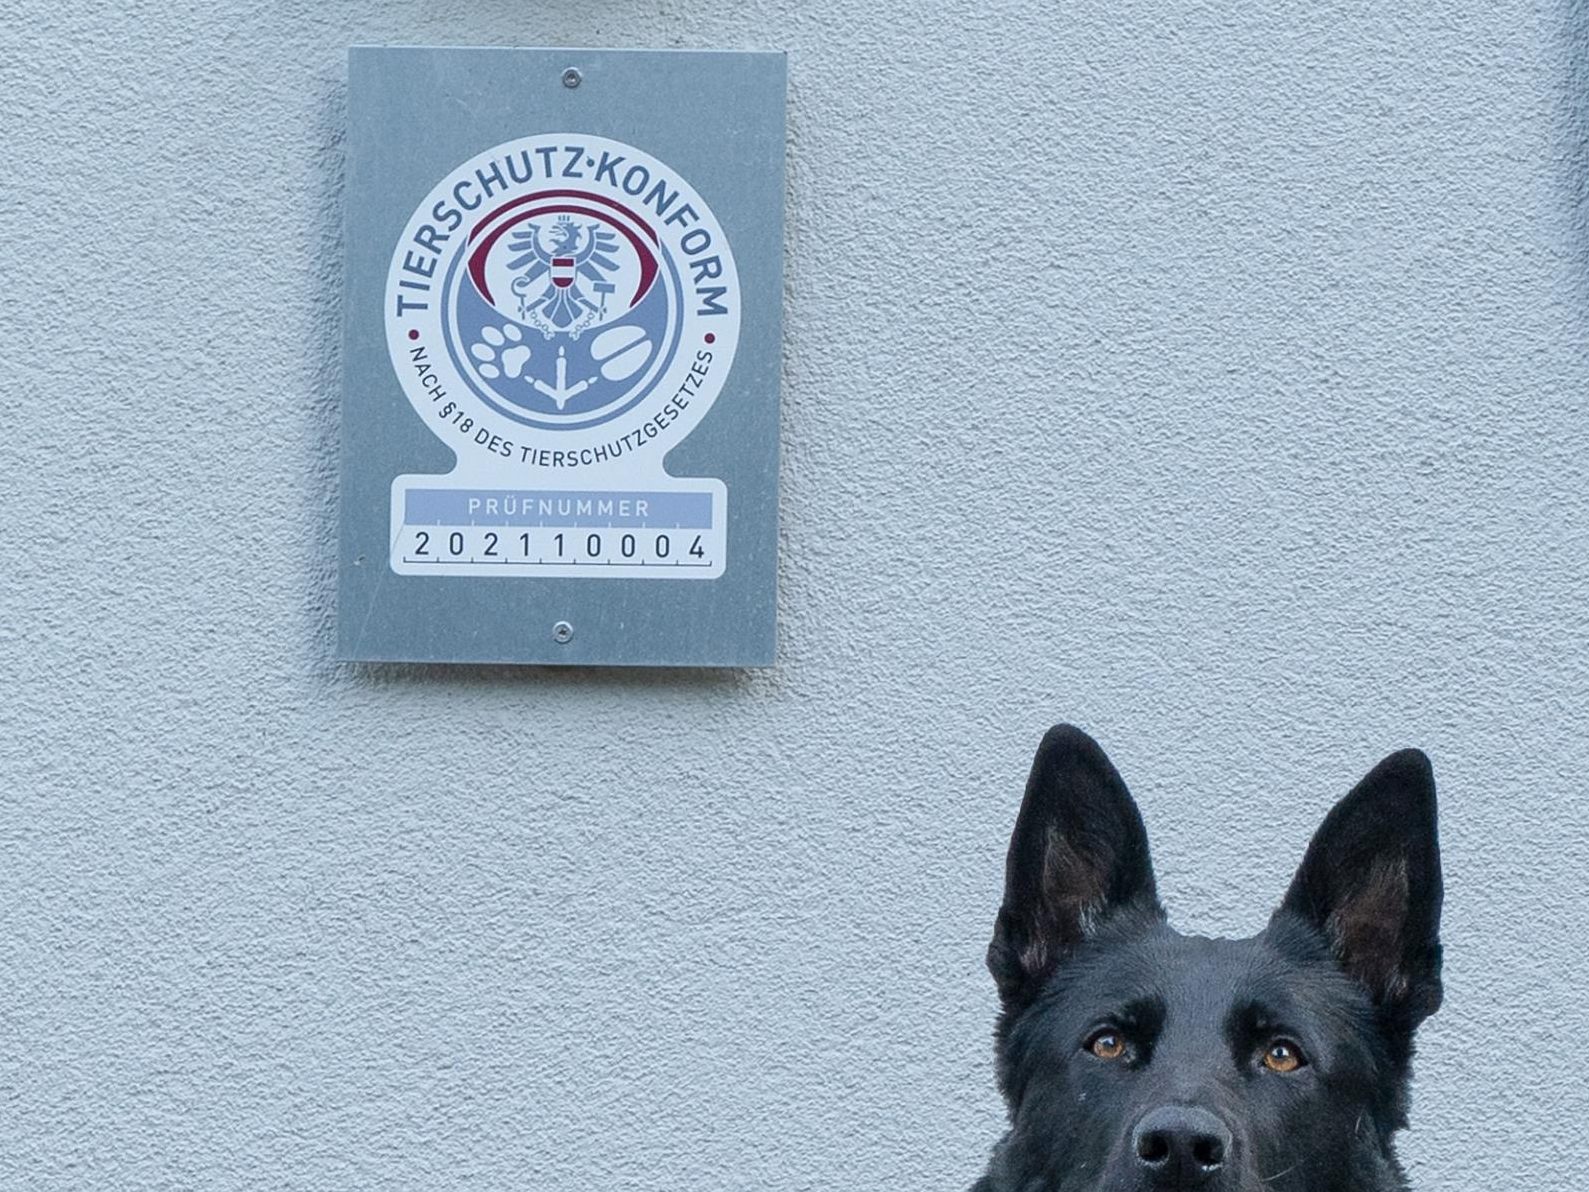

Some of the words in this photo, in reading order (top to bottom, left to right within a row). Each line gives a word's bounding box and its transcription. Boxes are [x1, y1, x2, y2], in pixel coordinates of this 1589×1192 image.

[409, 346, 447, 402] NACH
[438, 401, 475, 434] §18
[474, 427, 514, 458] DES
[520, 349, 714, 468] TIERSCHUTZGESETZES
[468, 496, 650, 518] PRÜFNUMMER
